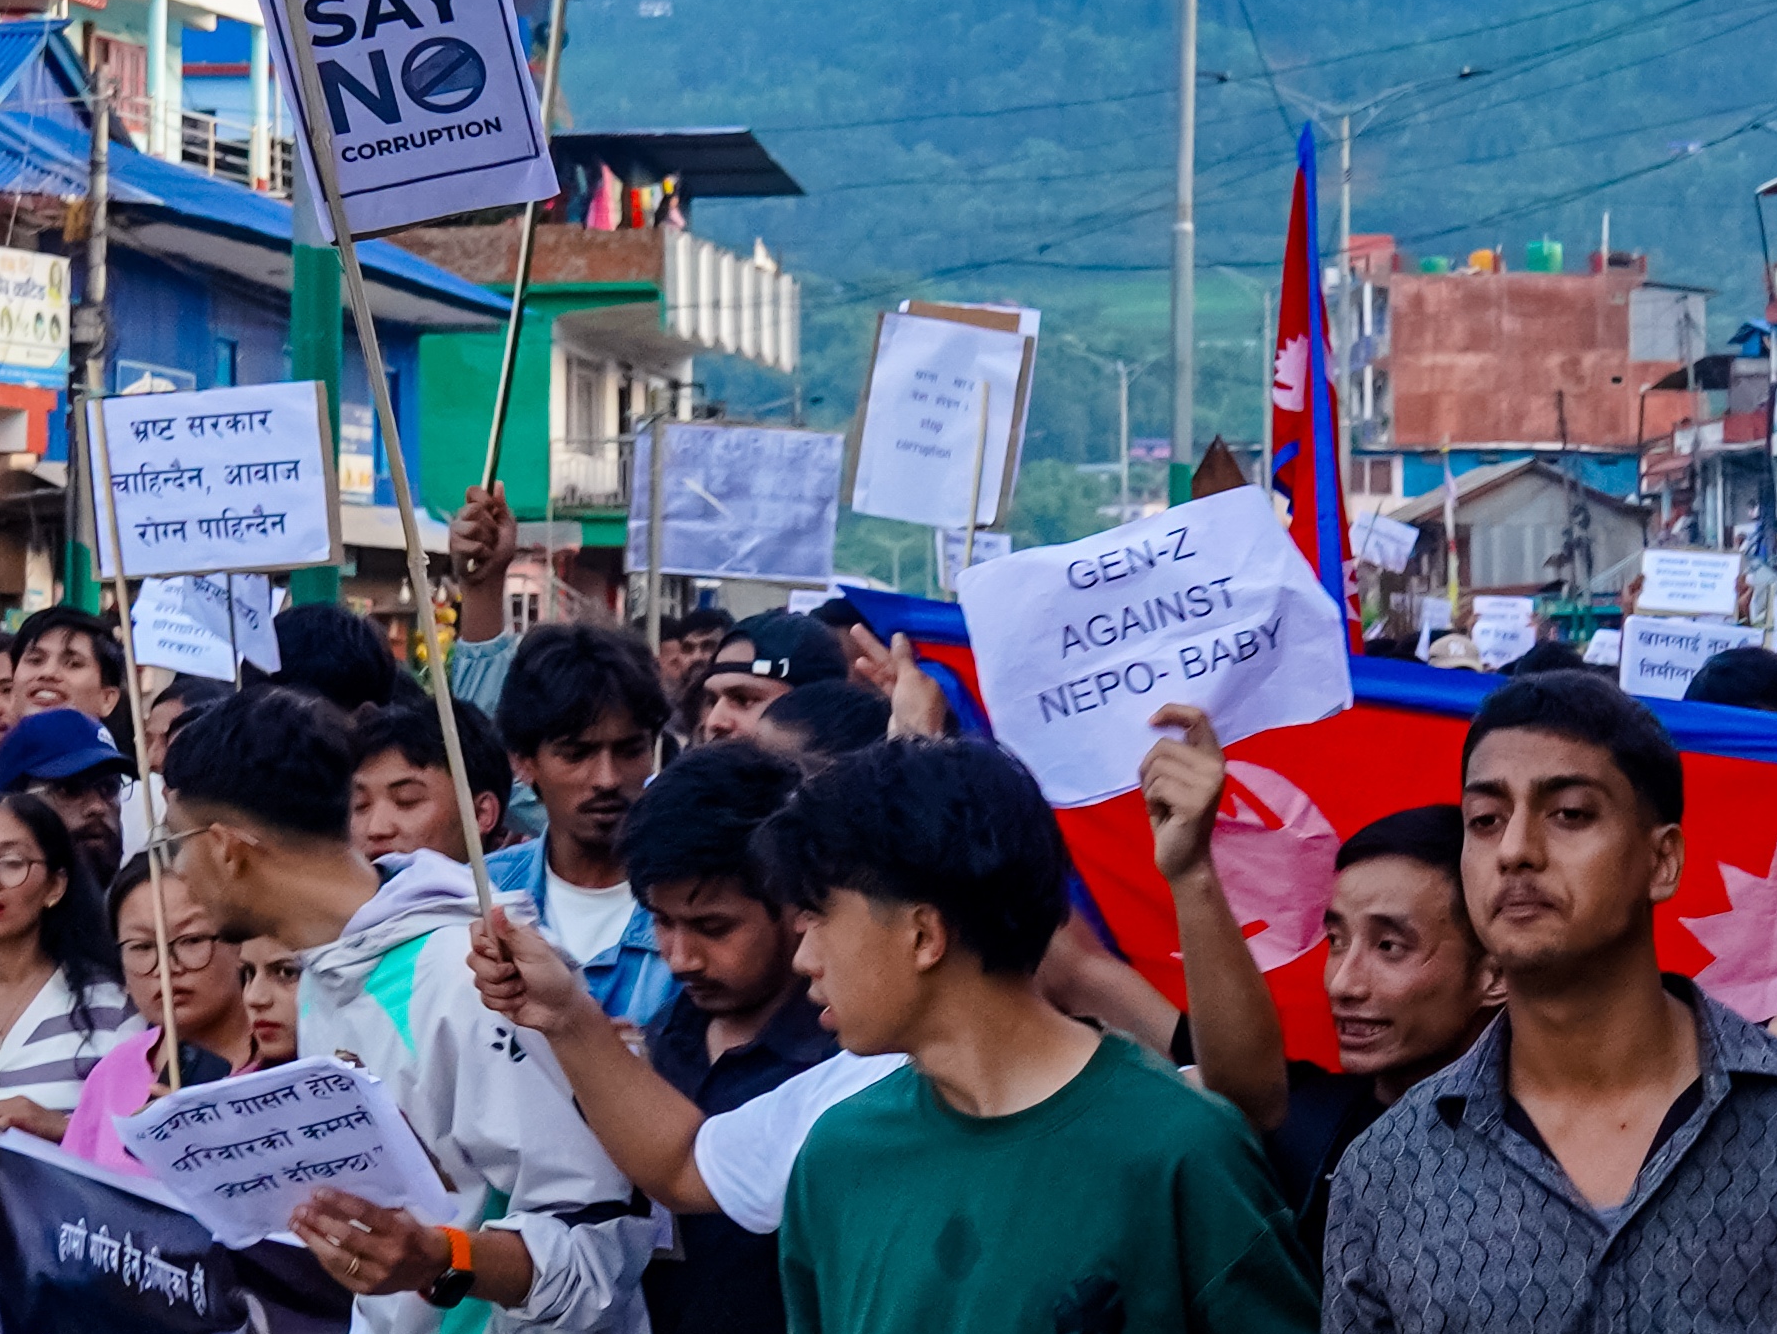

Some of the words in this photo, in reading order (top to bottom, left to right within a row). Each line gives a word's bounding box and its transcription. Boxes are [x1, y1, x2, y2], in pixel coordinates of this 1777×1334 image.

[317, 36, 487, 136] NO
[341, 117, 503, 163] CORRUPTION
[187, 409, 274, 438] सरकार
[223, 459, 302, 487] आवाज
[1066, 526, 1197, 590] GEN-Z
[1062, 576, 1235, 659] AGAINST
[1180, 616, 1284, 681] BABY
[228, 1083, 300, 1118] शासन
